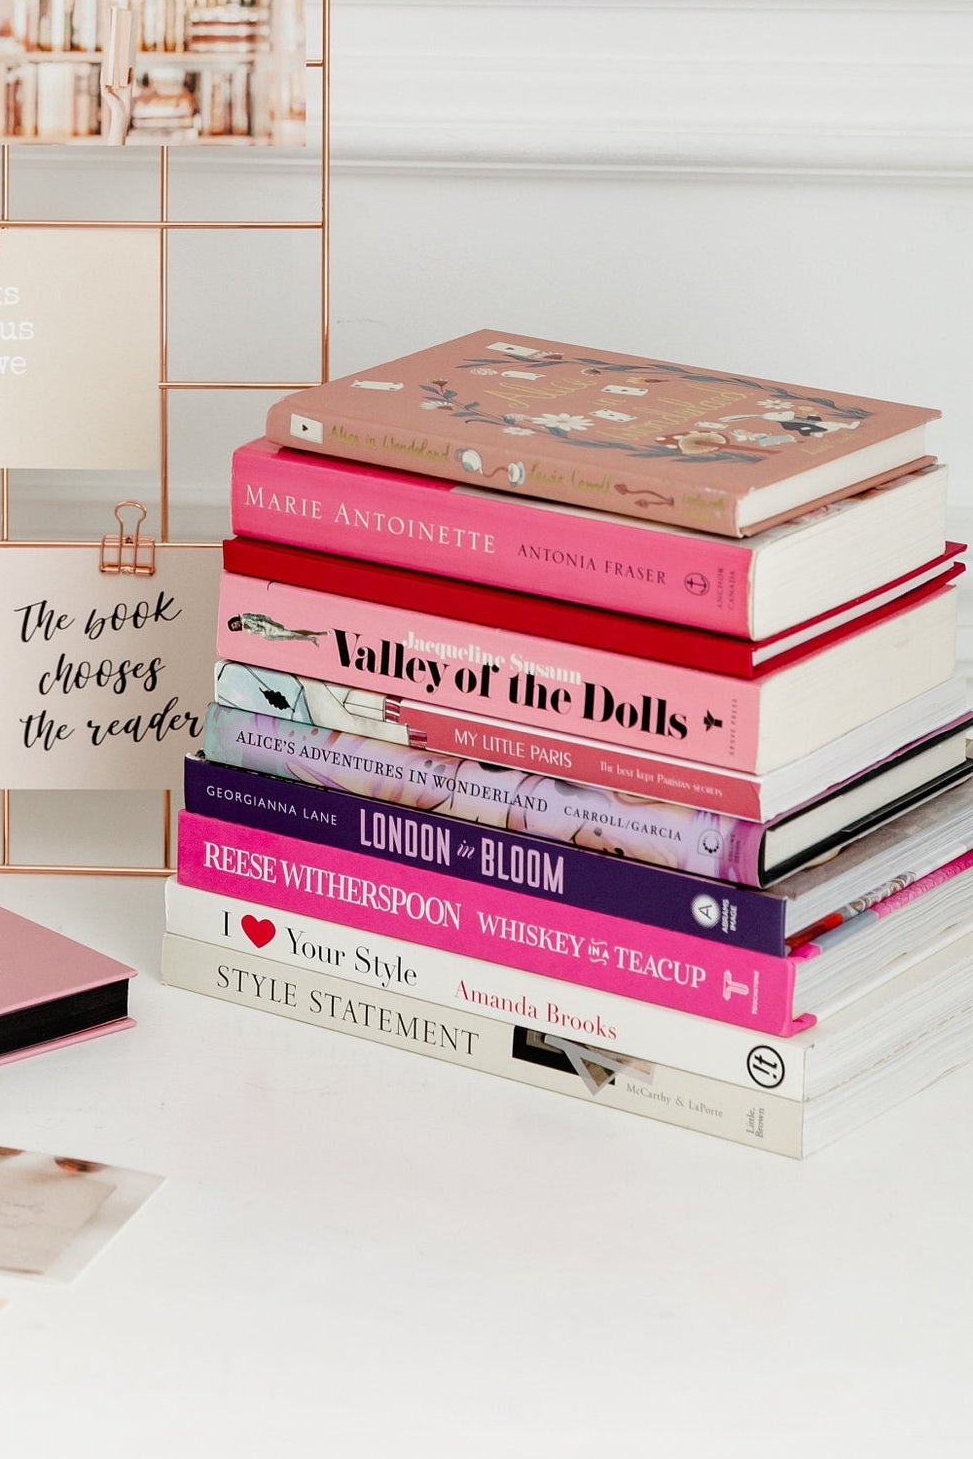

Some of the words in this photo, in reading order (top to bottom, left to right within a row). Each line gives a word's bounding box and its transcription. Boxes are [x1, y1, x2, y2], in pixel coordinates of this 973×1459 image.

[245, 484, 323, 519] MARIE
[334, 503, 496, 554] ANTOINETTE
[518, 544, 596, 571] ANTONIA
[605, 560, 666, 585] FRASER
[14, 599, 75, 643] The
[84, 591, 182, 640] book
[39, 653, 165, 695] chooses
[333, 628, 449, 694] Valley
[455, 661, 500, 698] of
[509, 671, 572, 715] the
[582, 682, 688, 740] Dolls
[402, 631, 505, 667] Jacqueline
[510, 653, 582, 685] Susann
[20, 710, 75, 751] the
[87, 697, 204, 746] reader
[454, 728, 478, 747] MY
[482, 734, 525, 759] LITTLE
[531, 744, 572, 769] PARIS
[236, 730, 295, 755] ALICE'S
[299, 745, 404, 780] ADVENTURES
[408, 770, 427, 785] IN
[432, 774, 548, 813] WONDERLAND
[206, 785, 296, 816] GEORGIANNA
[303, 808, 337, 826] LANE
[564, 806, 682, 841] CARROLL/GARCIA
[360, 808, 450, 866] LONDON
[457, 840, 475, 859] in
[481, 837, 564, 894] BLOOM
[204, 841, 276, 884] REESE
[280, 860, 461, 930] WITHERSPOON
[221, 910, 232, 937] I
[285, 927, 345, 967] Your
[354, 946, 418, 988] Style
[477, 911, 585, 958] WHISKEY
[588, 945, 600, 956] IN
[602, 949, 610, 960] A
[614, 946, 706, 988] TEACUP
[217, 965, 297, 1008] STYLE
[309, 990, 479, 1056] STATEMENT
[455, 980, 538, 1020] Amanda
[547, 1003, 618, 1040] Brooks
[626, 1083, 672, 1106] McCarthy
[675, 1096, 684, 1107] &
[688, 1100, 723, 1117] LaPorte
